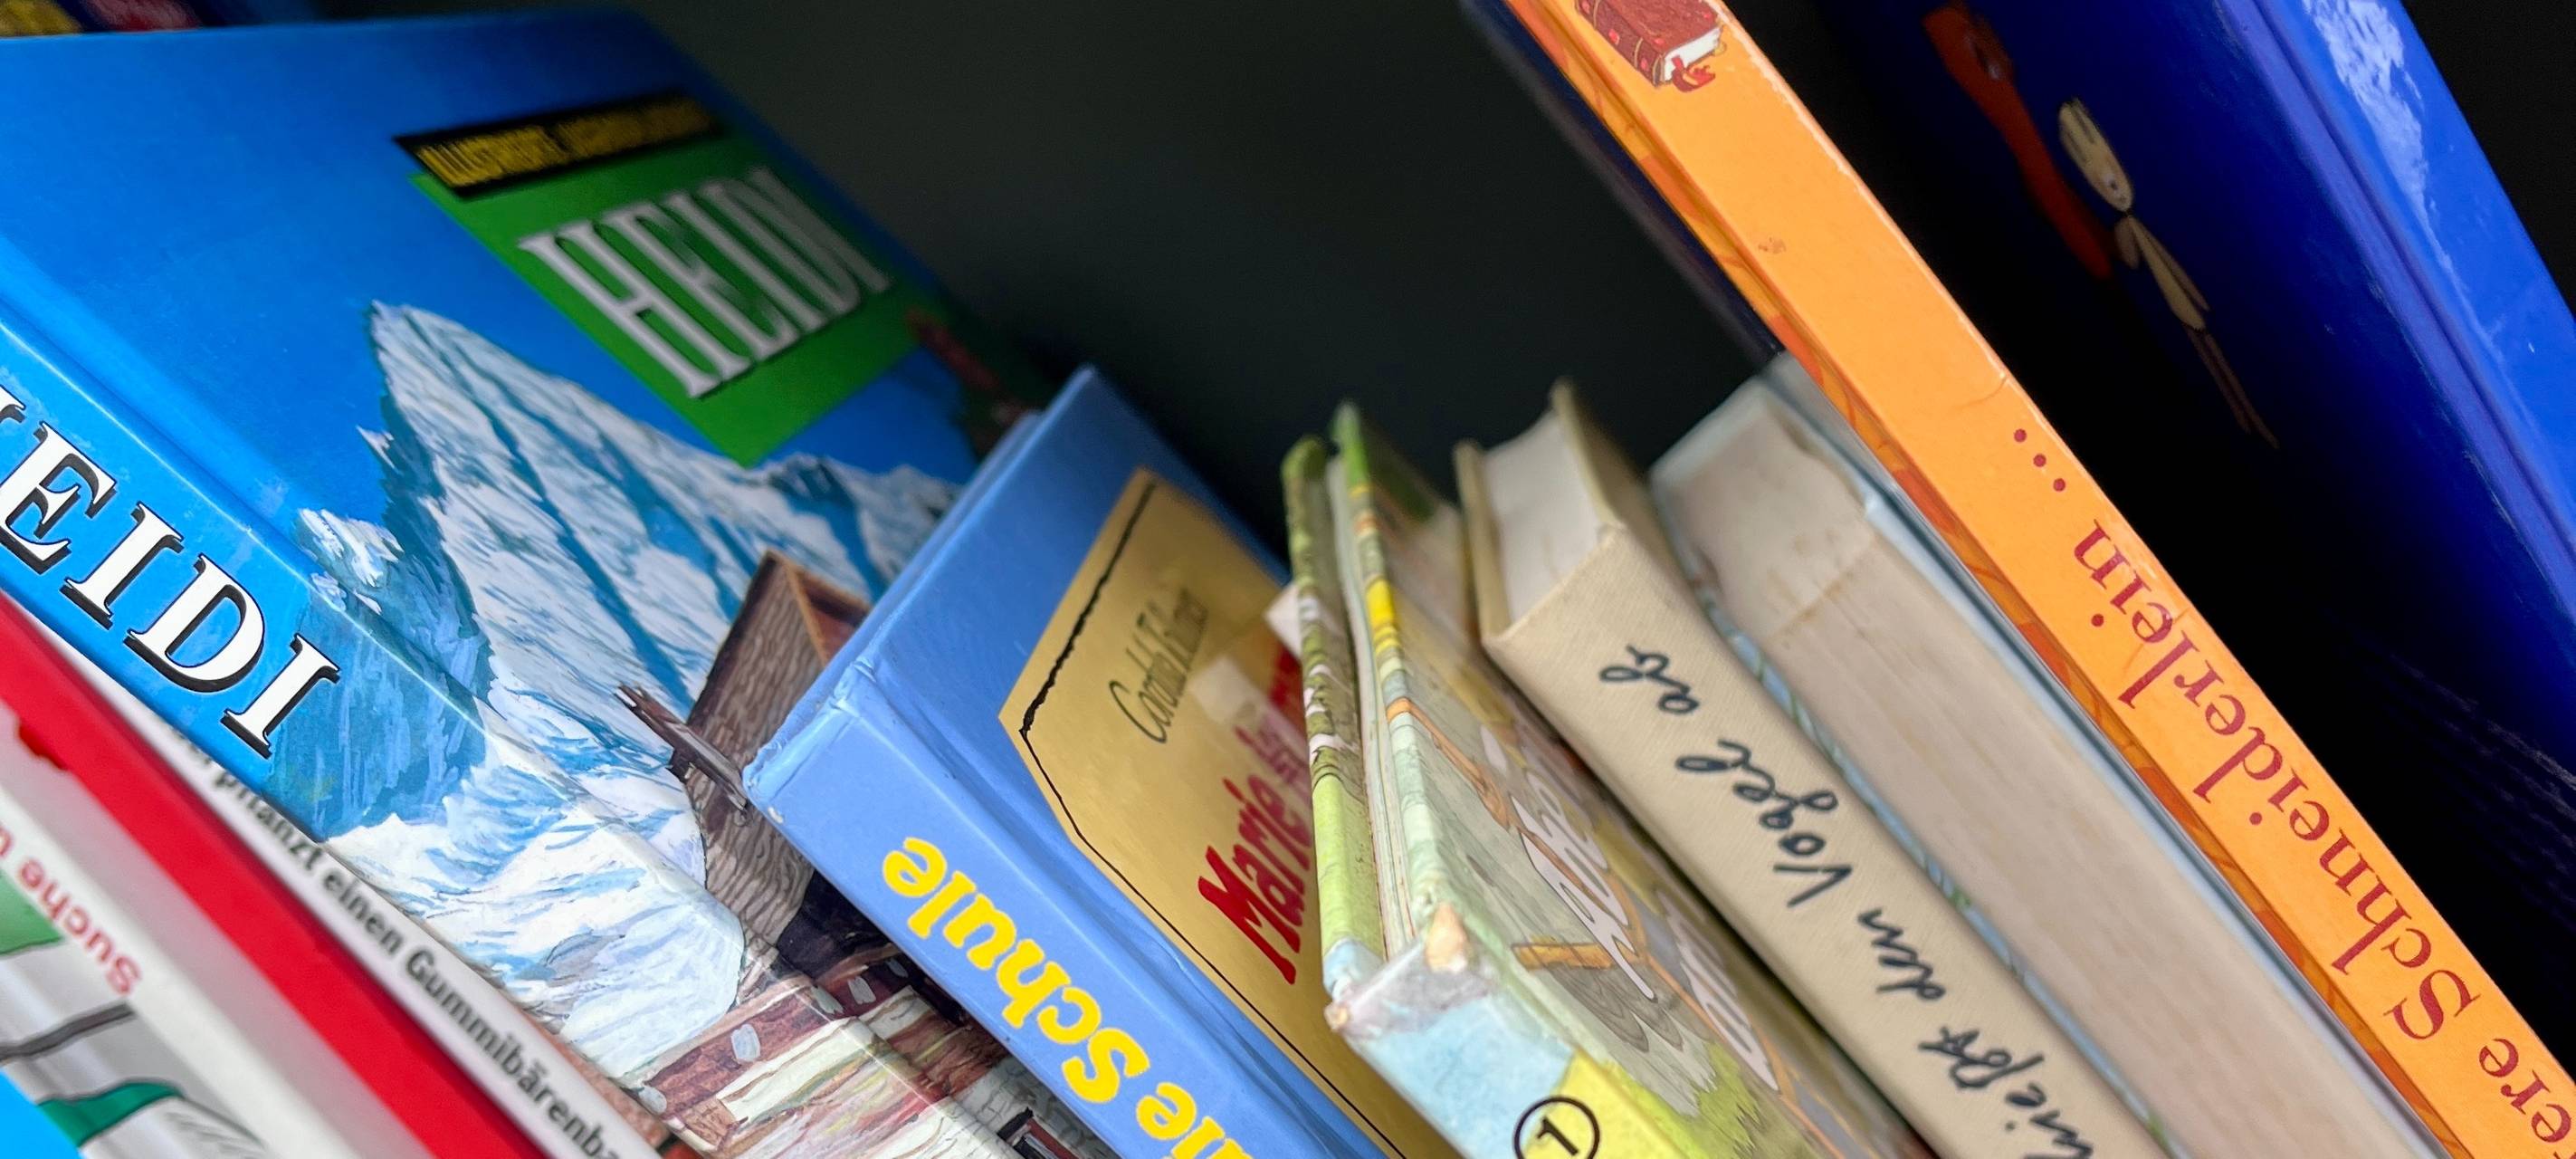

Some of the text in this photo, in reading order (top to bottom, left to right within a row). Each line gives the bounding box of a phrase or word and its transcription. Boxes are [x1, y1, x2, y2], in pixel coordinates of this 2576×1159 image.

[518, 166, 890, 398] HEIDI
[0, 384, 340, 759] EIDI
[1599, 644, 1700, 714] ab
[2074, 519, 2481, 1041] Schneiderlein
[18, 860, 142, 994] Suche
[1197, 775, 1312, 985] Marie
[1675, 739, 1853, 908] Vogel
[322, 870, 405, 956] einen
[405, 948, 619, 1159] Gummibärenb
[883, 838, 1150, 1103] Schule
[1857, 908, 1946, 999] den
[2478, 1038, 2576, 1159] ere
